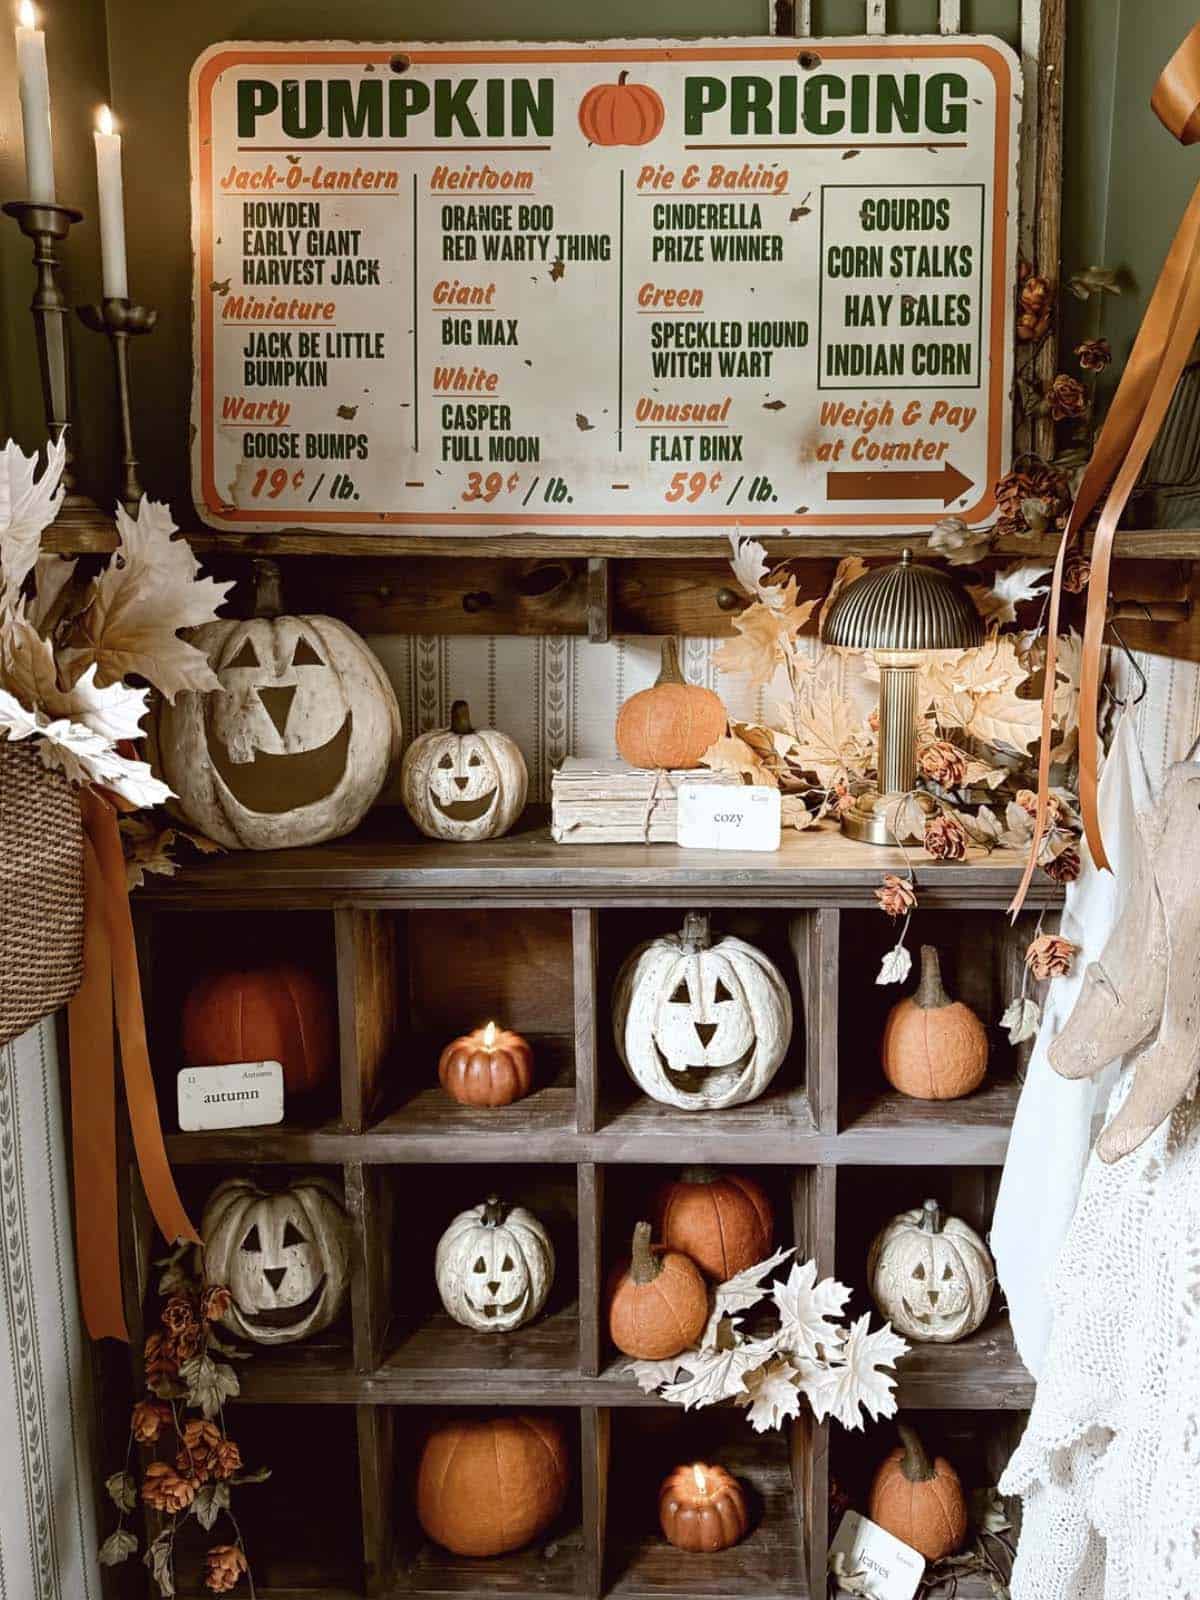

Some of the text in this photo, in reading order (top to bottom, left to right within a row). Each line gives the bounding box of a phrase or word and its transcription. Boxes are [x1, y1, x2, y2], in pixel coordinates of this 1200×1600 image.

[237, 72, 968, 139] PUMPKIN PRICING
[220, 165, 399, 191] Jack-O-Lantern
[431, 166, 533, 190] Heirloom
[637, 165, 790, 195] Pie & Baking
[243, 202, 320, 228] HOWDEN
[442, 205, 553, 232] ORANGE BOO
[653, 203, 762, 230] CINDERELLA
[861, 198, 950, 232] GOURDS
[243, 230, 361, 257] EARLY GIANT
[443, 234, 611, 262] RED WARTY THING
[653, 235, 783, 262] PRIZE WINNER
[243, 259, 380, 286] HARVEST JACK
[828, 245, 972, 279] CORN STALKS
[433, 280, 495, 306] Giant
[638, 283, 703, 308] Green
[223, 296, 336, 321] Miniature
[844, 294, 971, 327] HAY BALES
[244, 332, 384, 359] JACK BE LITTLE
[442, 319, 518, 346] BIG MAX
[651, 321, 808, 348] SPECKLED HOUND
[244, 361, 327, 387] BUMPKIN
[652, 351, 773, 378] WITCH WART
[826, 344, 972, 377] INDIAN CORN
[433, 367, 498, 392] White
[222, 397, 290, 424] Warty
[442, 405, 511, 431] CASPER
[636, 397, 731, 422] Unusual
[819, 401, 976, 434] Weigh & Pay
[243, 433, 368, 460] GOOSE BUMPS
[442, 436, 540, 462] FULL MOON
[650, 436, 743, 462] FLAT BINX
[816, 435, 948, 462] at Counter
[251, 468, 305, 499] 19¢
[462, 471, 519, 503] 39¢
[664, 471, 722, 503] 59¢
[713, 813, 744, 828] cozy
[203, 1089, 259, 1104] autumn
